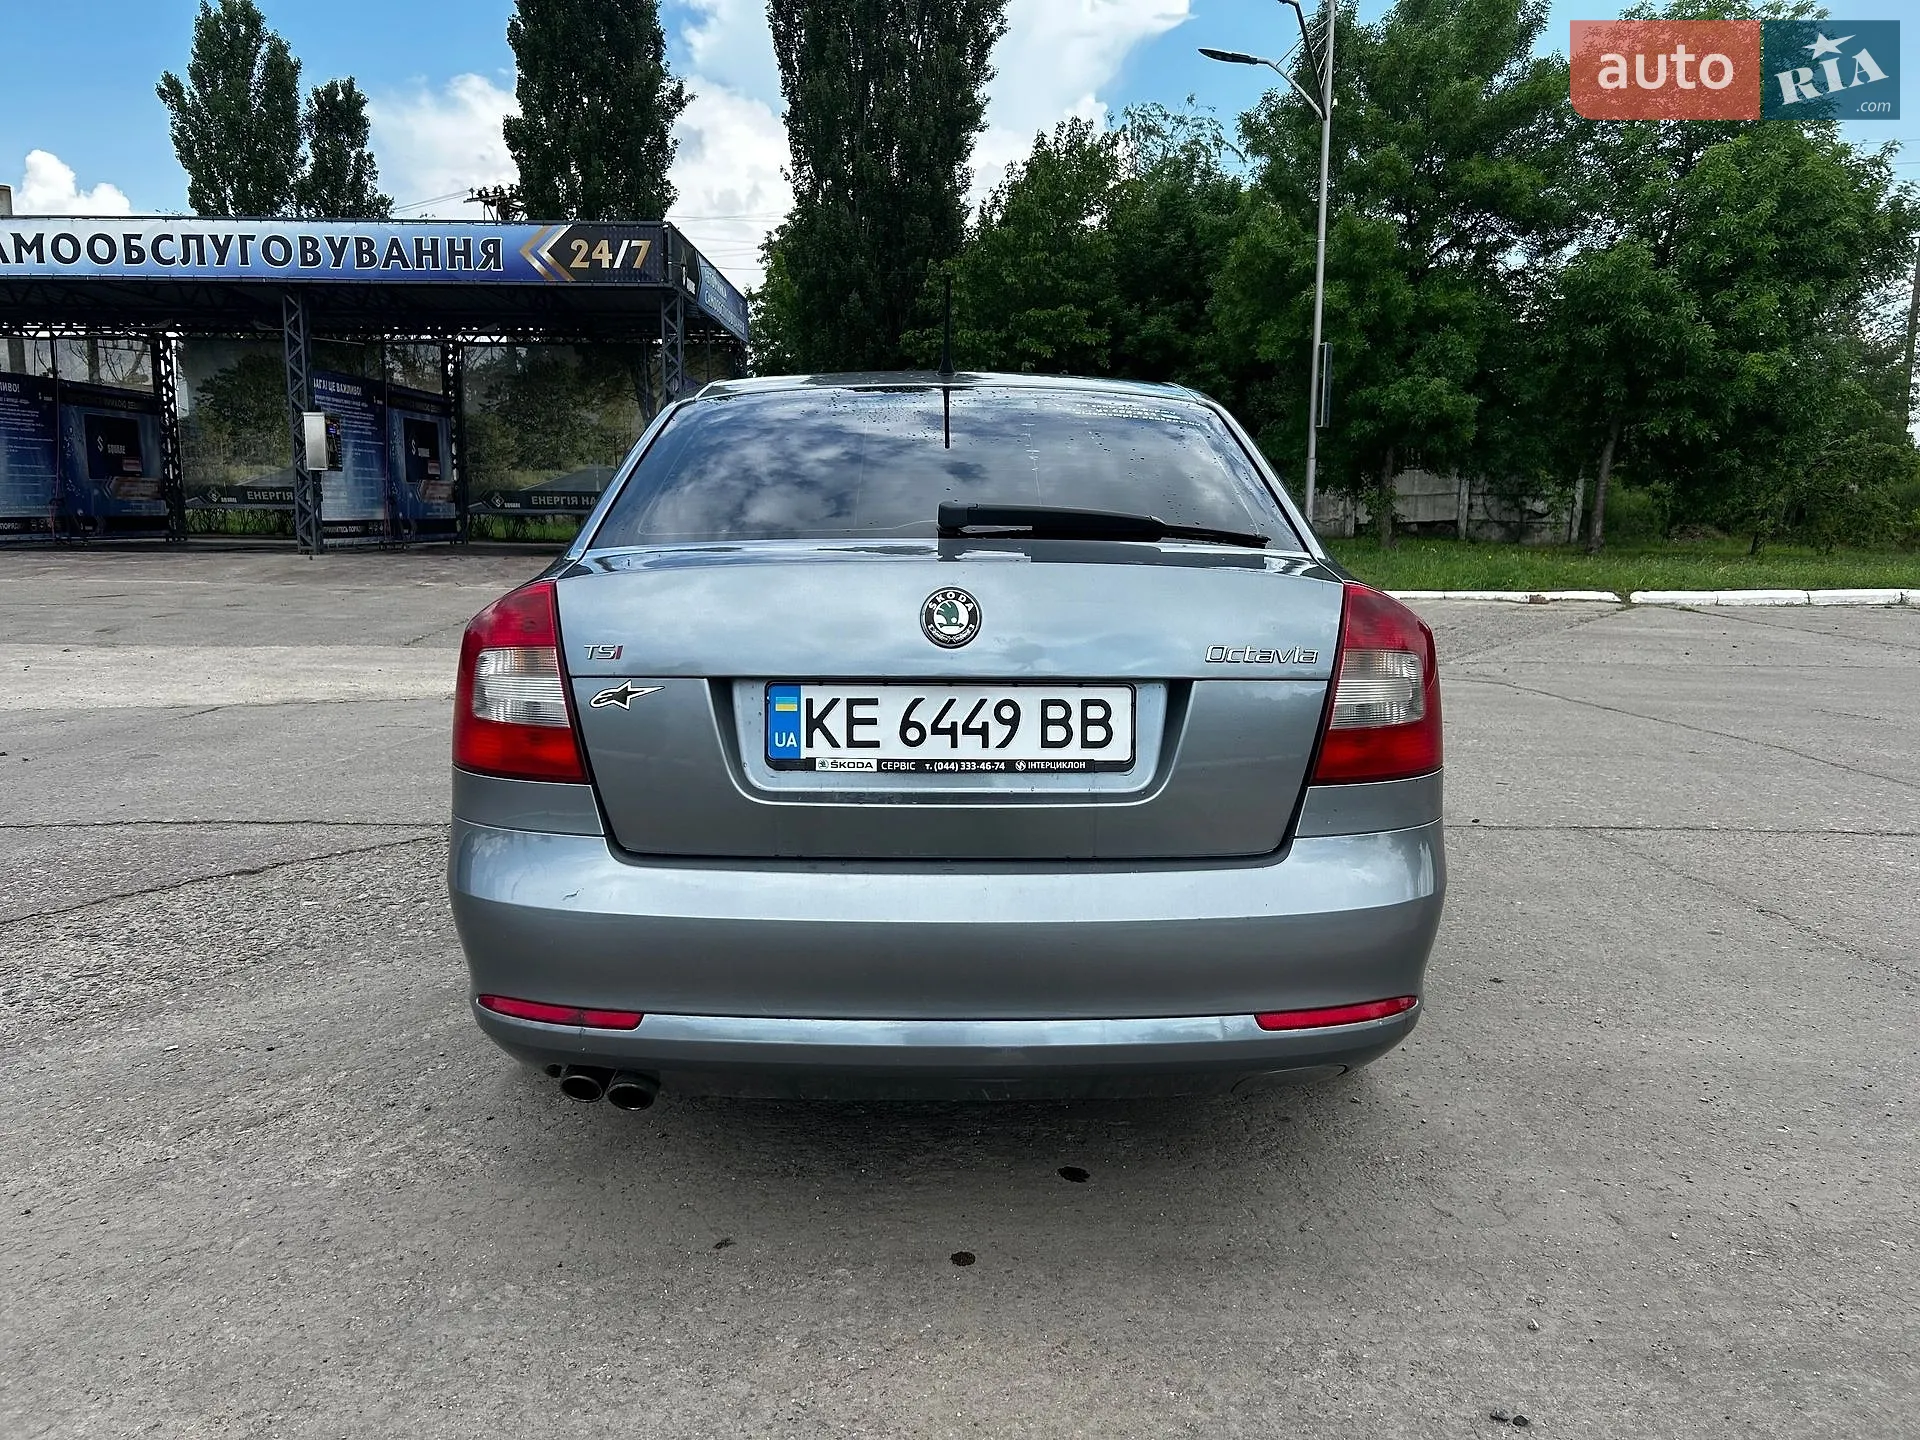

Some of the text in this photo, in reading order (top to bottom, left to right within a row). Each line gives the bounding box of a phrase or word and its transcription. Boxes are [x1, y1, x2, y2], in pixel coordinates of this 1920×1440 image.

[569, 239, 651, 269] 24/7
[246, 491, 293, 501] ЕНЕРГІЯ
[531, 496, 578, 505] ЕНЕРГІЯ
[584, 644, 624, 660] TSI
[1204, 644, 1319, 664] Octavia
[899, 697, 1022, 749] 6449
[774, 732, 798, 748] UA
[830, 760, 874, 769] ŠKODA
[881, 761, 916, 770] СЕРВІС
[960, 762, 1005, 770] 333-46-74
[1028, 761, 1086, 771] ІНТЕРЦИКЛОН
